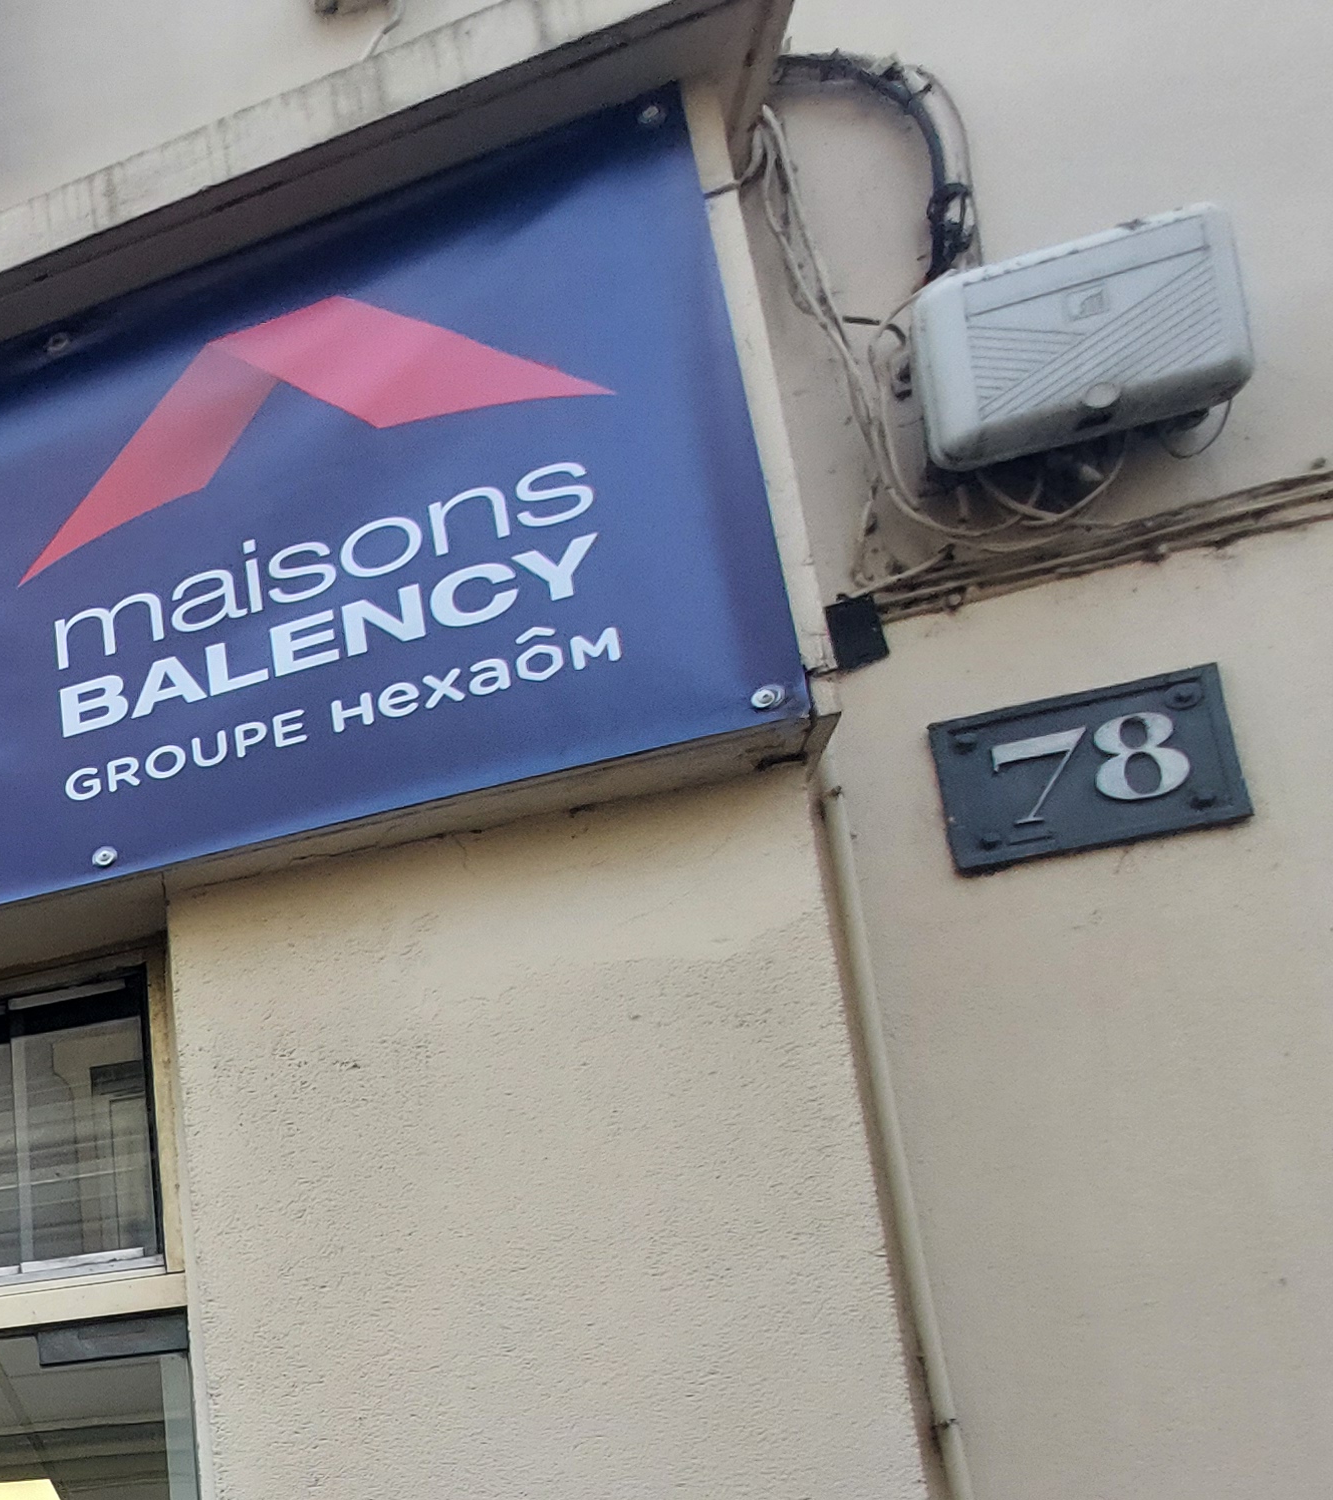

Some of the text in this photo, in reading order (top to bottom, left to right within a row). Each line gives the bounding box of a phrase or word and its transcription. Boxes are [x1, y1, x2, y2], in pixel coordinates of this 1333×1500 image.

[55, 462, 595, 669] maisons
[59, 532, 597, 737] BALENCY
[65, 709, 307, 800] GROUPE
[990, 711, 1190, 825] 78
